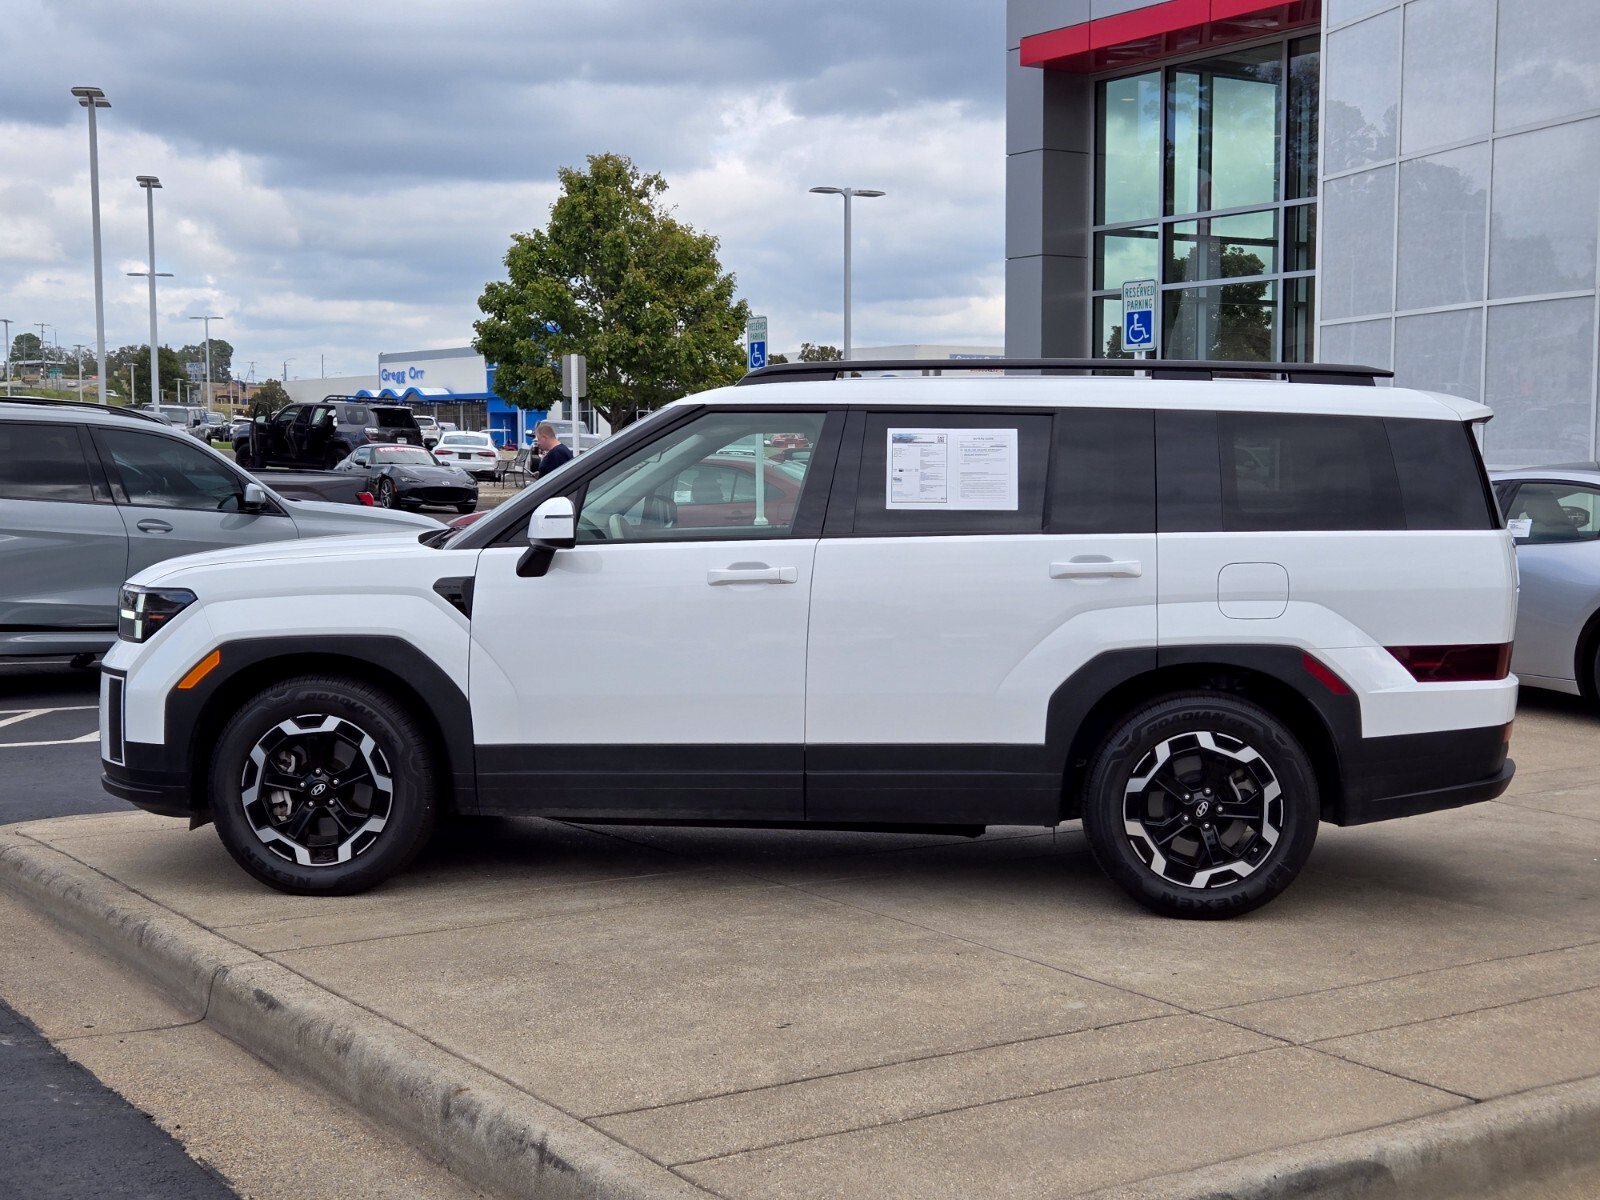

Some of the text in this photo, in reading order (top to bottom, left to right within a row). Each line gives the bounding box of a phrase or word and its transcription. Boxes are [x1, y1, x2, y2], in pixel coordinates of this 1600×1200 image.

[1125, 286, 1154, 298] RESERVED
[1127, 298, 1152, 311] PARKING
[381, 366, 425, 384] Gregg Orr
